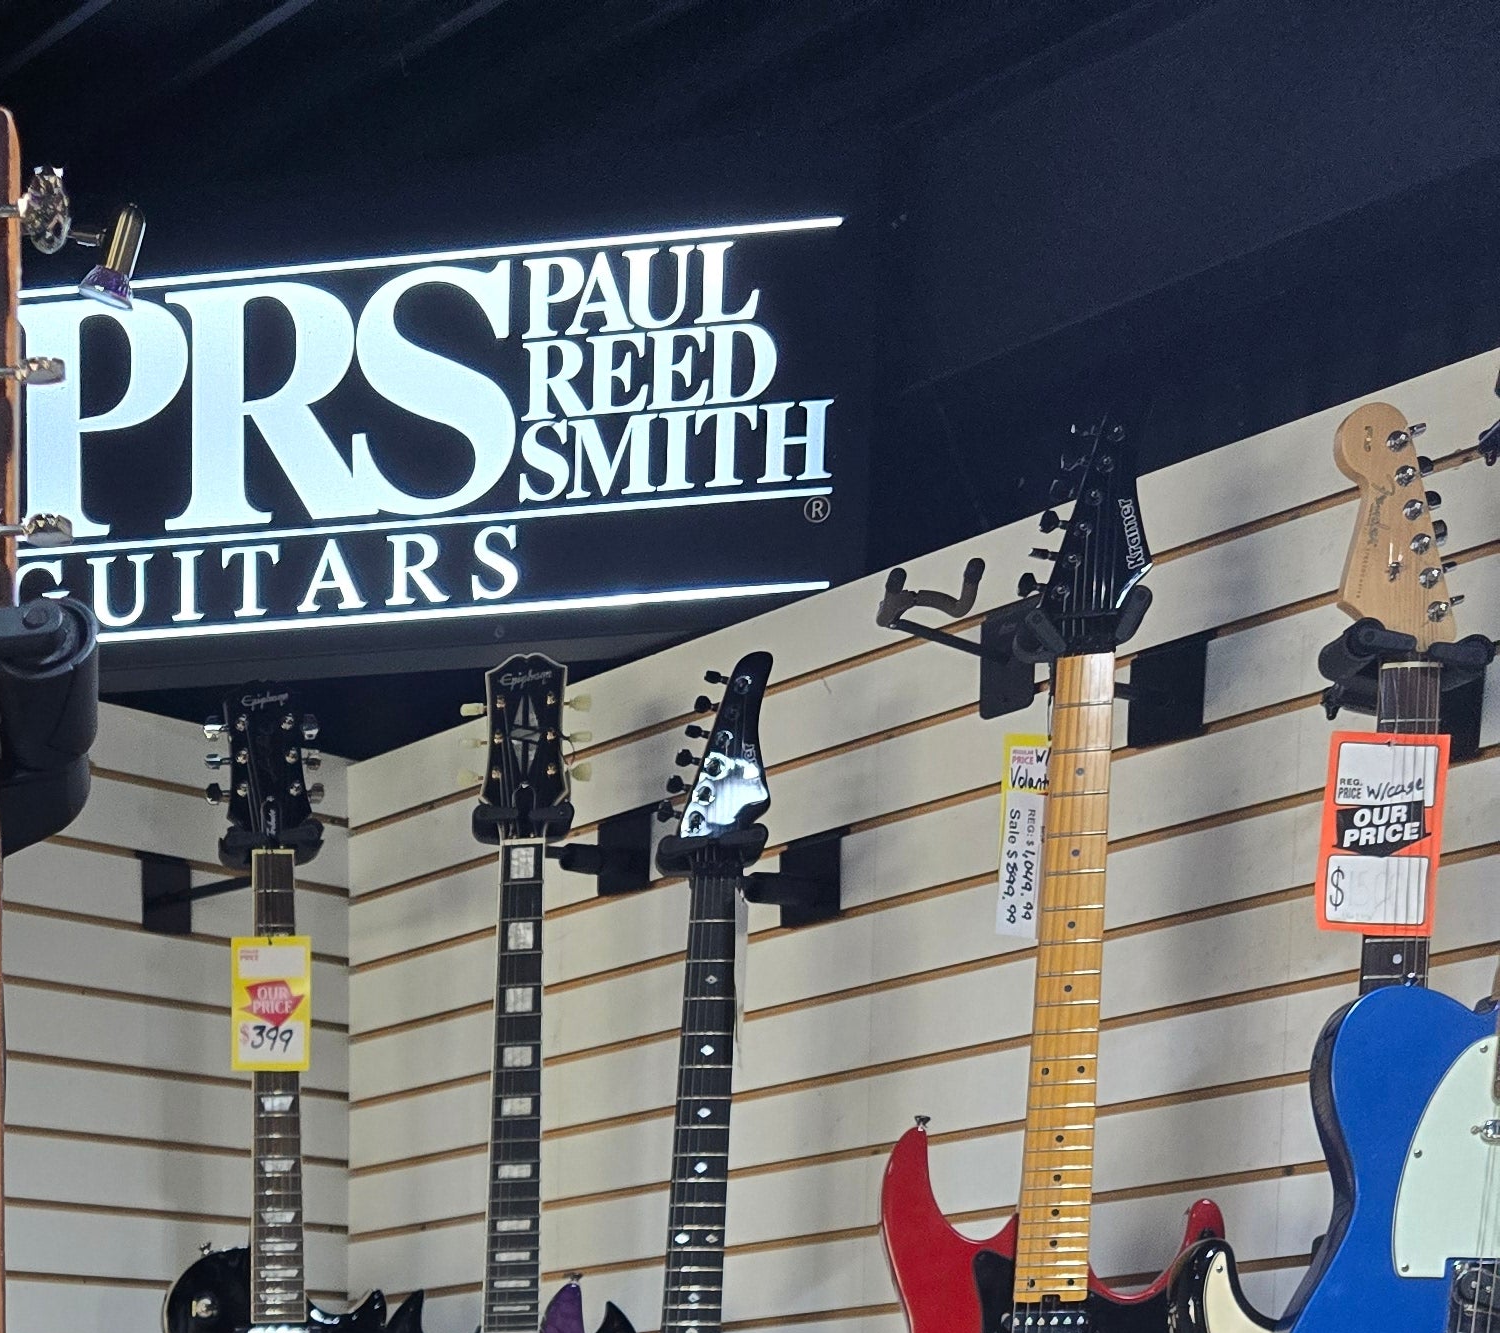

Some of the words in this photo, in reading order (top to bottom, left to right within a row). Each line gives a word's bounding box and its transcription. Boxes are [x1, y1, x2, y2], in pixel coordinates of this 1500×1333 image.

[521, 241, 761, 341] PAUL
[521, 323, 779, 422] REED
[21, 259, 516, 537] PRS
[518, 399, 835, 505] SMITH
[1118, 499, 1145, 570] Kramer
[16, 524, 521, 627] GUITARS
[500, 669, 552, 691] Epiphone
[241, 691, 289, 711] Epiphone
[1012, 755, 1034, 765] PRICE
[1338, 786, 1362, 799] PRICE
[1339, 778, 1362, 786] REG.
[1008, 808, 1021, 845] Sale
[1353, 805, 1407, 827] OUR
[1343, 821, 1420, 848] PRICE
[1329, 866, 1344, 911] $
[257, 986, 288, 1000] OUR
[252, 1000, 293, 1014] PRICE
